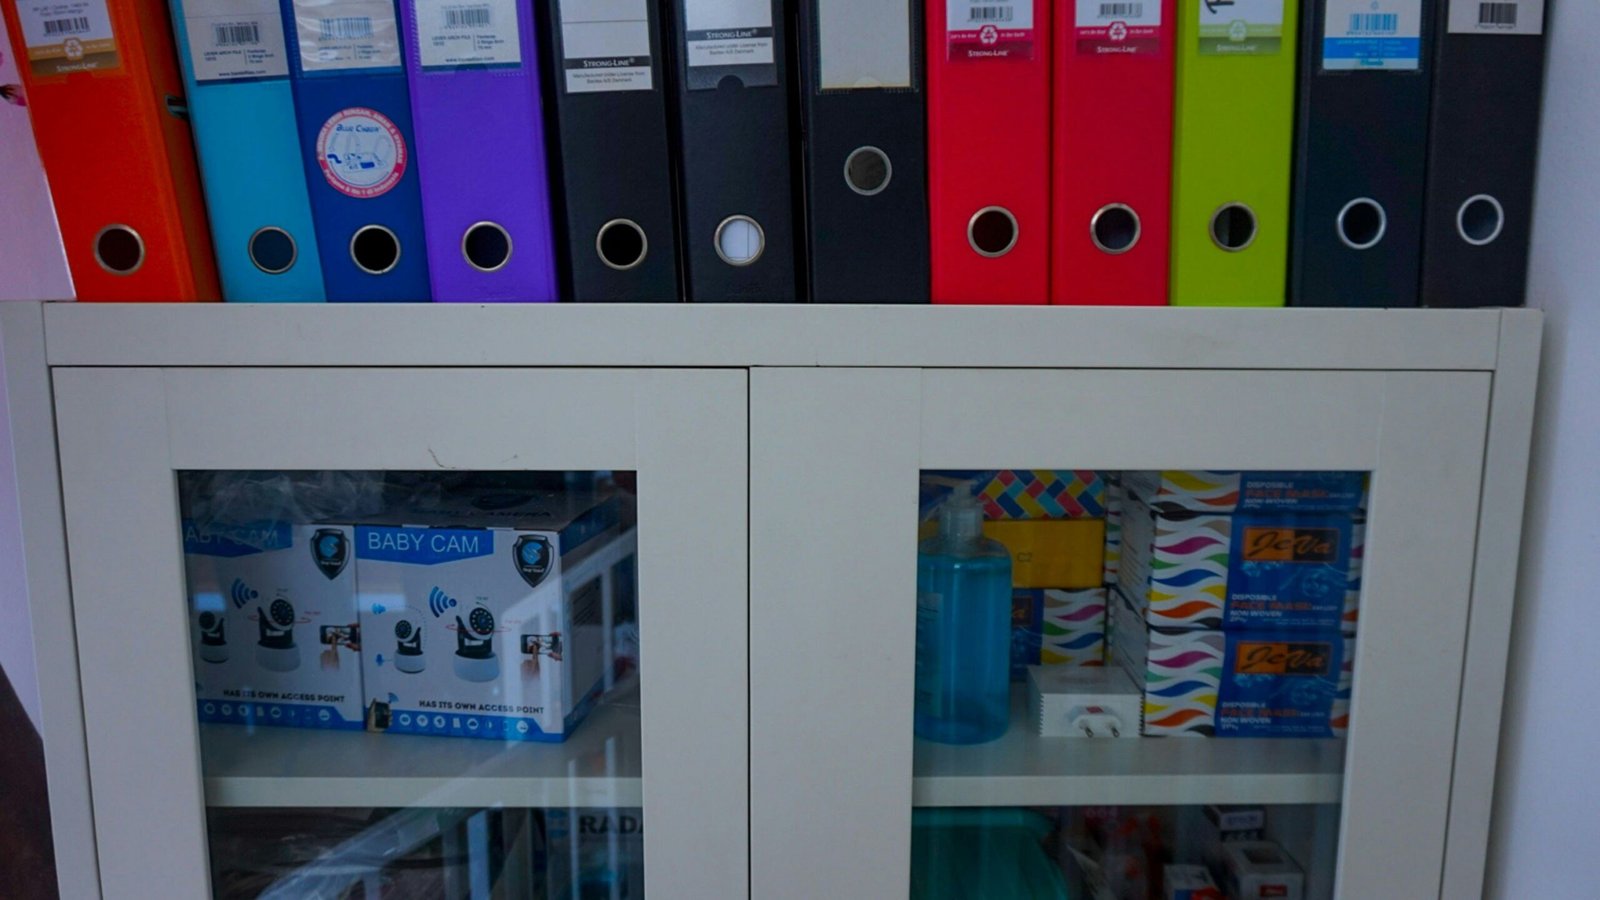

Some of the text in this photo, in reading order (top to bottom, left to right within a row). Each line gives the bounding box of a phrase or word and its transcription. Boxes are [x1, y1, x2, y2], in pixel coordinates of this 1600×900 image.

[368, 532, 479, 553] BABY CAM
[223, 689, 241, 698] HAS
[257, 690, 279, 699] OWN
[281, 692, 316, 701] ACCESS
[318, 695, 346, 703] POINT
[419, 700, 545, 714] HAS ITS OWN ACCESS POINT
